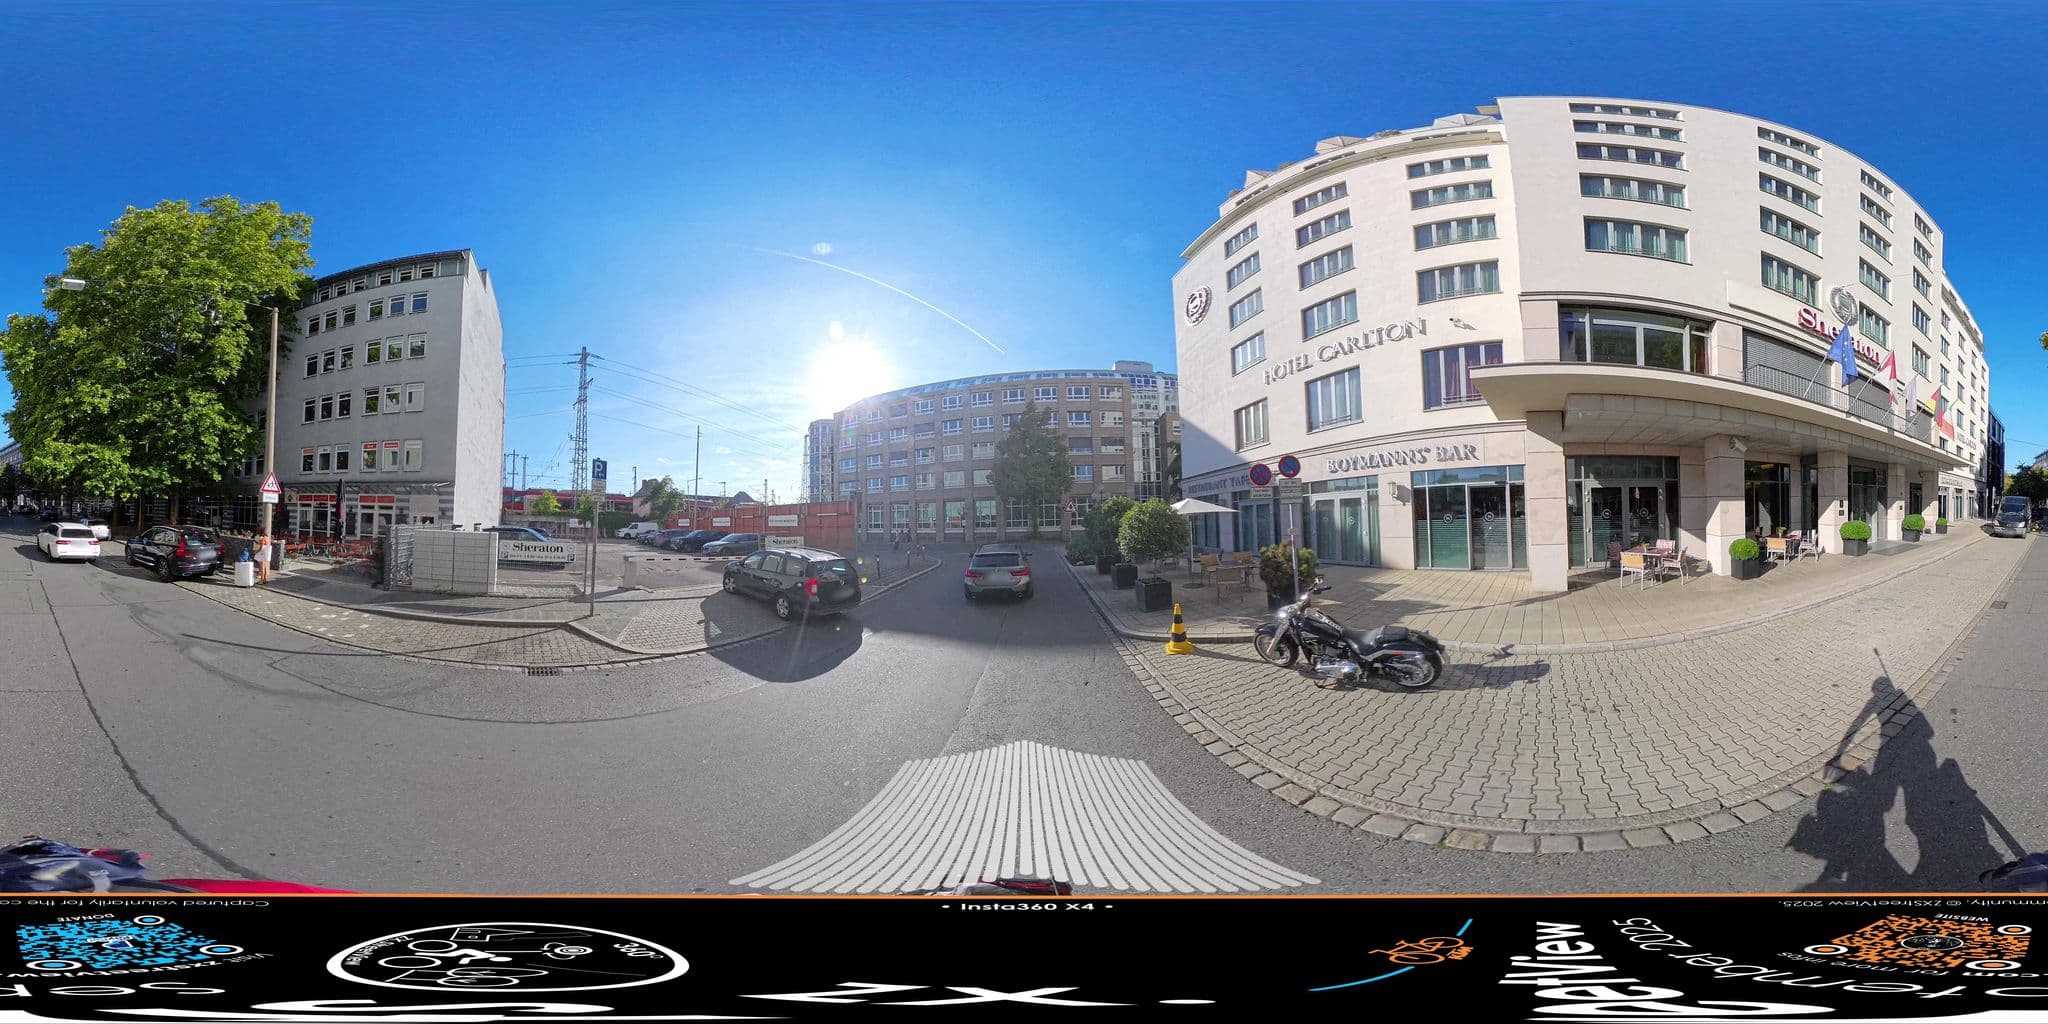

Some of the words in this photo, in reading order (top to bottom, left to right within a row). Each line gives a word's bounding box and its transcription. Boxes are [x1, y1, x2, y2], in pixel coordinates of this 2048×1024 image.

[1263, 352, 1313, 385] HOTEL
[1317, 317, 1428, 362] CARLTON
[1798, 307, 1881, 365] Sheaton
[1435, 443, 1480, 463] BAR
[512, 542, 564, 553] Sheraton
